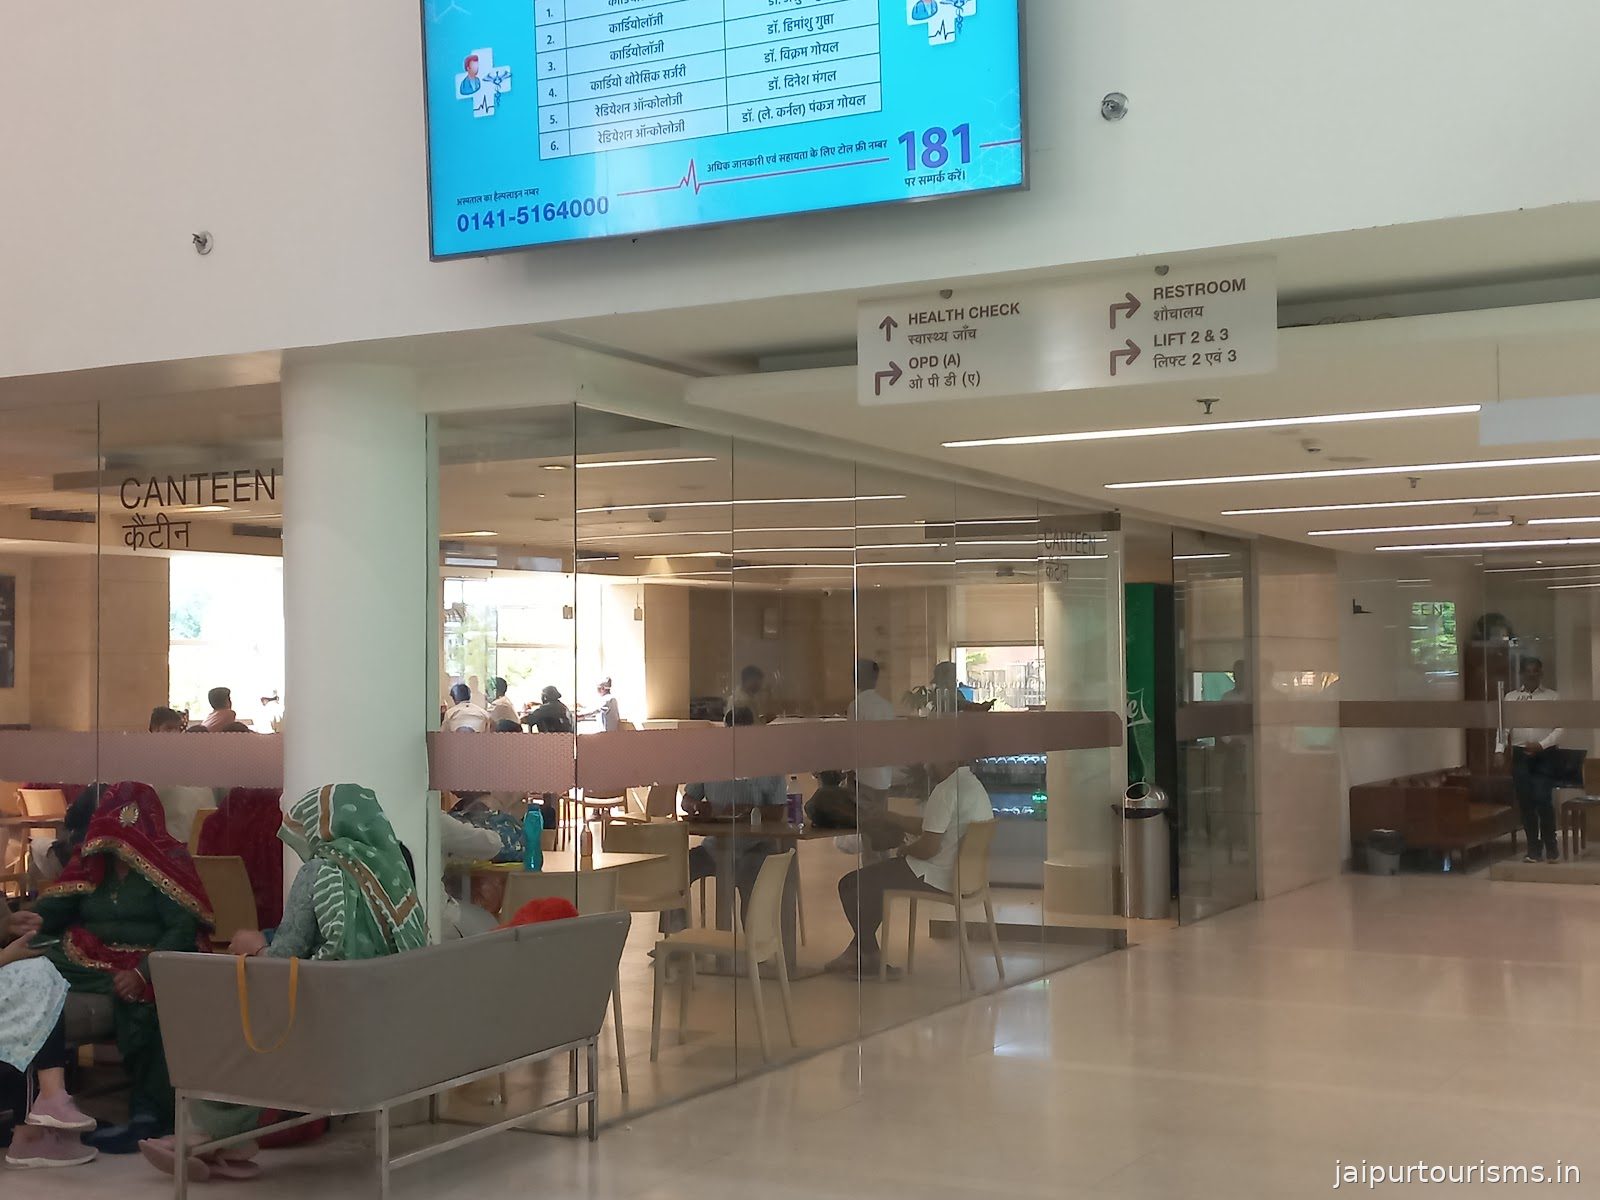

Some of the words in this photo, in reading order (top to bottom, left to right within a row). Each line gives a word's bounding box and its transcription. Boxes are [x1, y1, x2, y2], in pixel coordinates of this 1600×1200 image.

[546, 8, 554, 17] 1.
[608, 12, 663, 33] कार्डियोलॉजी
[767, 20, 780, 34] डॉ.
[783, 16, 813, 32] हिमांशु
[816, 13, 835, 30] गुप्ता
[547, 35, 555, 45] 2.
[610, 40, 664, 60] कार्डियोलॉजी
[764, 48, 777, 63] डॉ.
[780, 46, 808, 61] विक्रम
[810, 41, 839, 56] गोयल
[548, 61, 556, 71] 3.
[590, 74, 622, 91] कार्डियो
[625, 69, 660, 86] थोरेसिक
[662, 63, 686, 79] सर्जरी
[768, 76, 781, 91] डॉ.
[784, 73, 809, 88] दिनेश
[812, 70, 837, 83] मंगल
[549, 88, 557, 97] 4.
[595, 102, 631, 117] रेडियेशन
[633, 91, 683, 111] ऑन्कोलोजी
[742, 108, 754, 122] डॉ.
[757, 106, 773, 123] (ले.
[776, 102, 806, 118] कर्नल)
[808, 99, 834, 113] पंकज
[837, 94, 866, 109] गोयल
[550, 115, 558, 124] 5.
[598, 128, 633, 144] रेडियेशन
[636, 119, 685, 138] ऑन्कोलोजी
[551, 141, 559, 150] 6.
[707, 160, 730, 172] अधिक
[732, 155, 764, 169] जानकारी
[766, 153, 777, 164] एवं
[779, 151, 808, 163] सहायता
[810, 147, 818, 158] के
[820, 145, 835, 157] लिए
[838, 143, 853, 154] टोल
[868, 140, 888, 150] नम्बर
[898, 122, 970, 171] 181
[904, 177, 916, 187] पर
[457, 196, 609, 232] 0141-5164000
[1153, 278, 1246, 300] RESTROOM
[908, 308, 964, 325] HEALTH
[969, 302, 1020, 319] CHECK
[1153, 305, 1204, 321] शौचालय
[908, 331, 948, 345] स्वास्थ्य
[953, 325, 977, 341] जाँच
[1154, 332, 1186, 347] LIFT
[1190, 331, 1200, 344] 2
[1204, 330, 1215, 342] &
[1219, 328, 1229, 341] 3
[909, 355, 939, 369] OPD
[943, 353, 961, 368] (A)
[1153, 353, 1186, 369] लिफ्ट
[1192, 353, 1202, 366] 2
[1205, 348, 1223, 366] एवं
[1228, 350, 1237, 362] 3
[909, 375, 922, 390] ओ
[928, 373, 940, 388] पी
[944, 372, 957, 387] डी
[962, 371, 981, 388] (ए)
[120, 468, 276, 510] CANTEEN
[122, 512, 191, 551] कैंटीन
[1043, 527, 1096, 556] CANTEEN
